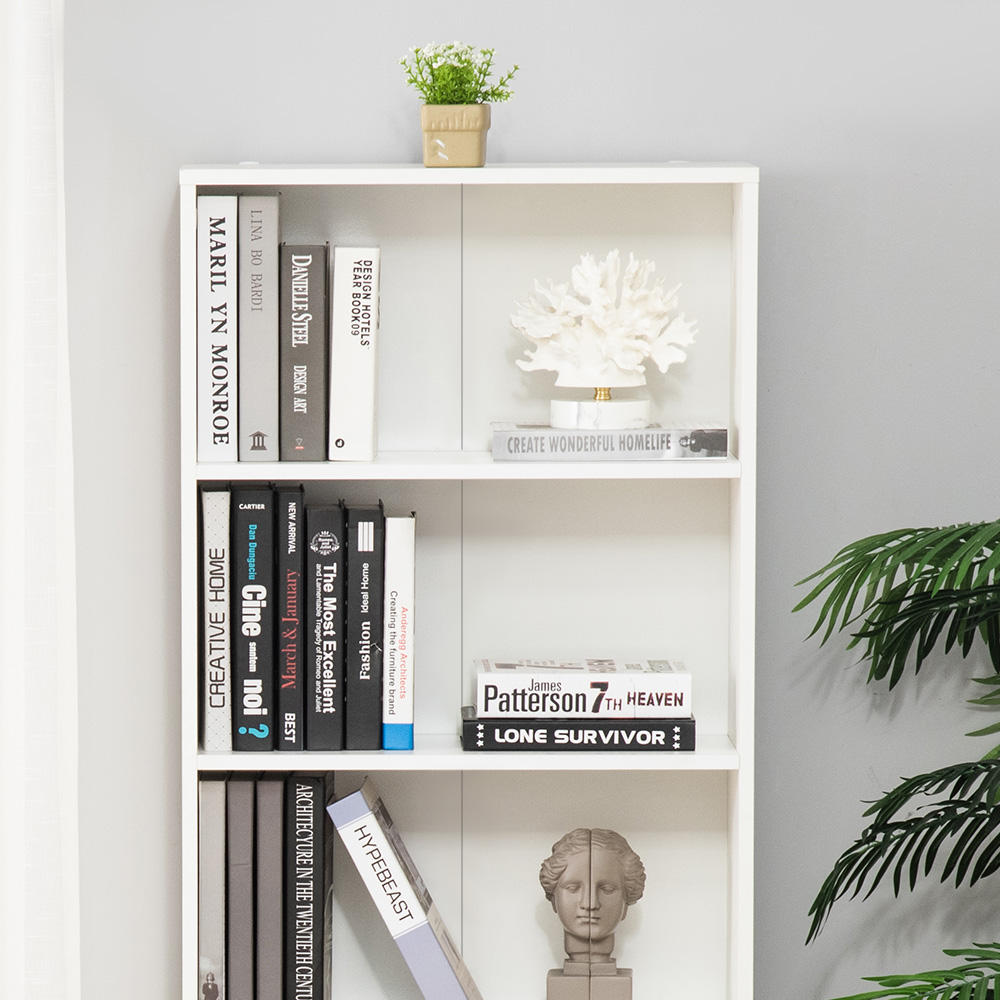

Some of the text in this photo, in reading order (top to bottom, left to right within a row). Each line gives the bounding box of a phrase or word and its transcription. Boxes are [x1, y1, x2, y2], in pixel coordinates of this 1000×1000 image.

[251, 211, 262, 311] LINA BO BARDI
[352, 260, 362, 288] YEAR
[360, 260, 372, 346] DESIGN HOTELS
[210, 217, 229, 445] MARIL YN MONROE
[291, 312, 312, 348] STEEL
[294, 366, 307, 413] DESIGN ART
[507, 433, 671, 454] CREATE WONDERFUL HOMELIFE
[287, 502, 296, 554] NEW ARRIVAL
[247, 525, 257, 580] Dan Dungaciu
[323, 563, 337, 592] The
[209, 548, 225, 708] CREATIVE HOME
[242, 585, 267, 636] Cine
[282, 569, 300, 688] March & January
[314, 618, 322, 645] Tragedy
[321, 598, 336, 644] Most
[359, 563, 372, 679] Fashion Ideal Home
[316, 646, 322, 654] of
[388, 590, 398, 715] Creating the furniture brand
[398, 606, 408, 699] Anderegg Architects
[243, 679, 267, 715] noi
[321, 645, 336, 713] Excellent
[484, 685, 587, 712] Patterson
[528, 680, 562, 692] James
[627, 692, 683, 706] HEAVEN
[285, 713, 295, 743] BEST
[495, 729, 665, 744] LONE SURVIVOR
[296, 867, 314, 878] IN
[296, 881, 314, 900] THE
[354, 825, 413, 921] HYPEBEAST
[296, 904, 314, 964] TWENTIETH
